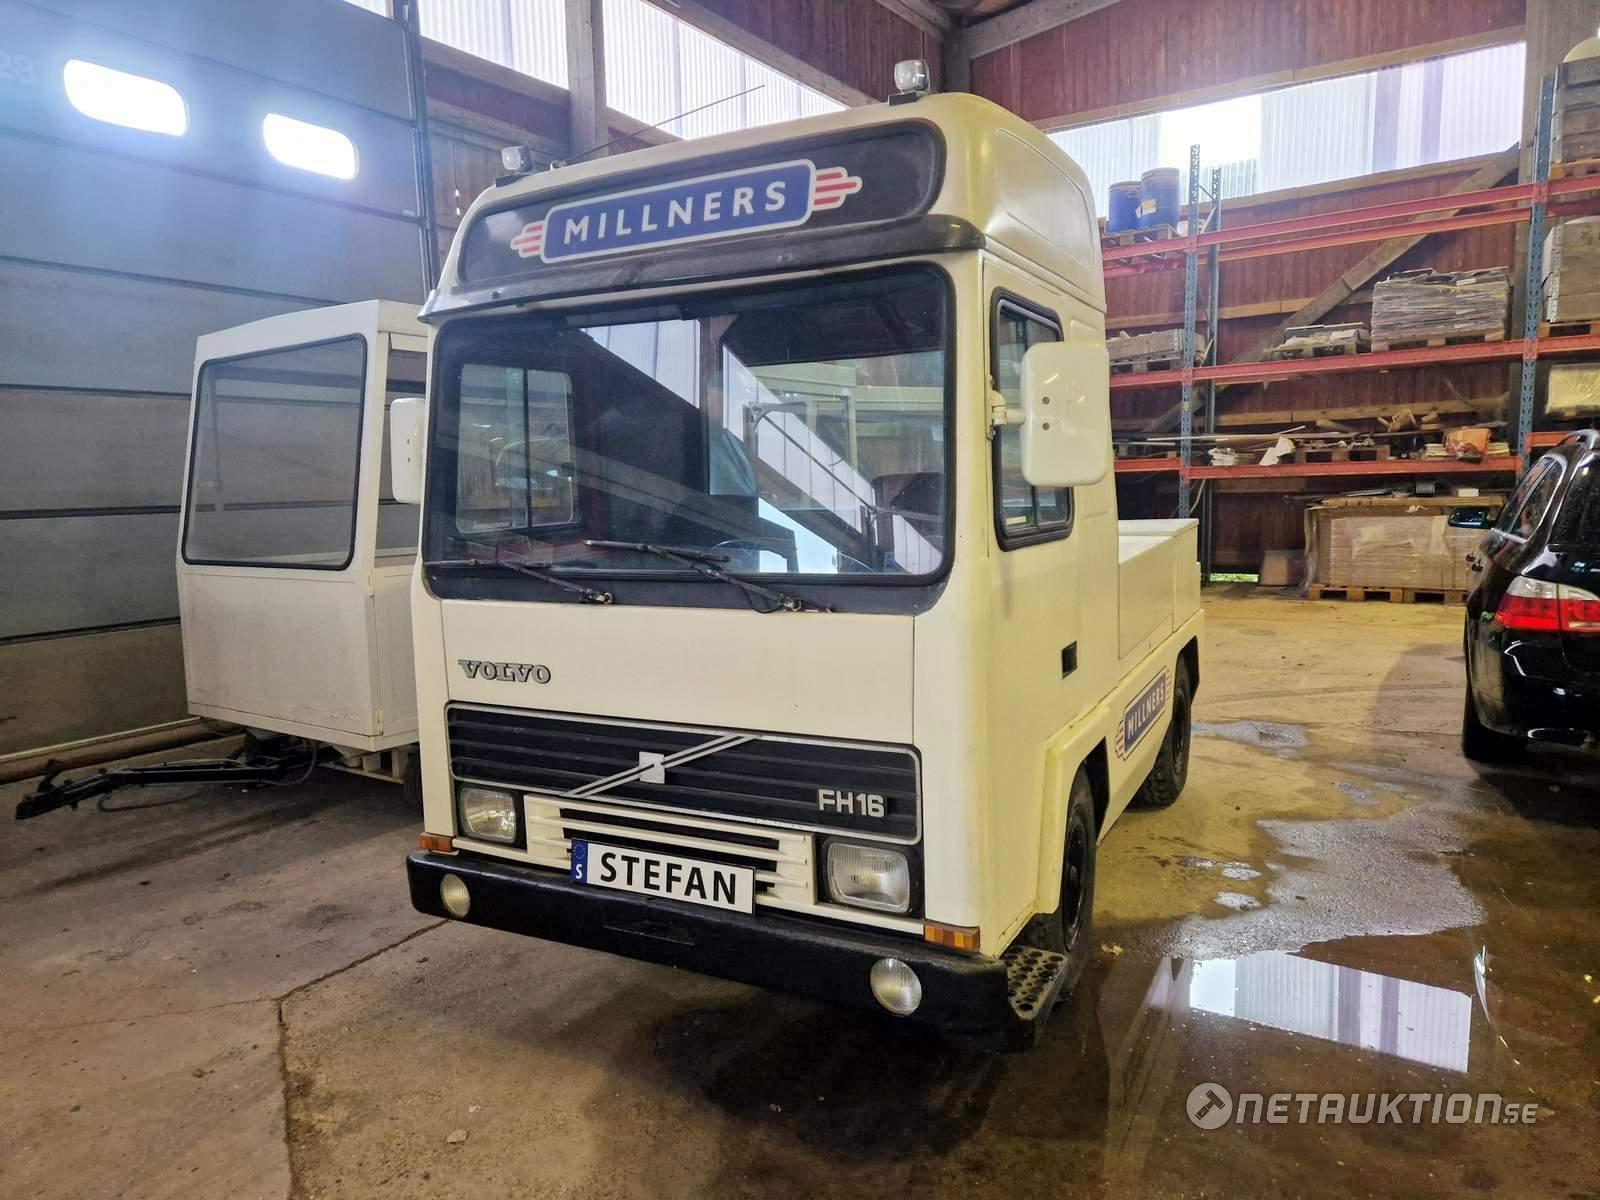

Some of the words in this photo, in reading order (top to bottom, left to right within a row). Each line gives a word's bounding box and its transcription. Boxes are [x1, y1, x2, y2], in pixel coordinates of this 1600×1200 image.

[563, 181, 787, 245] MILLNERS
[457, 659, 551, 684] VOLVO
[1127, 682, 1165, 740] MILLNERS
[575, 864, 583, 879] S
[600, 852, 736, 905] STEFAN
